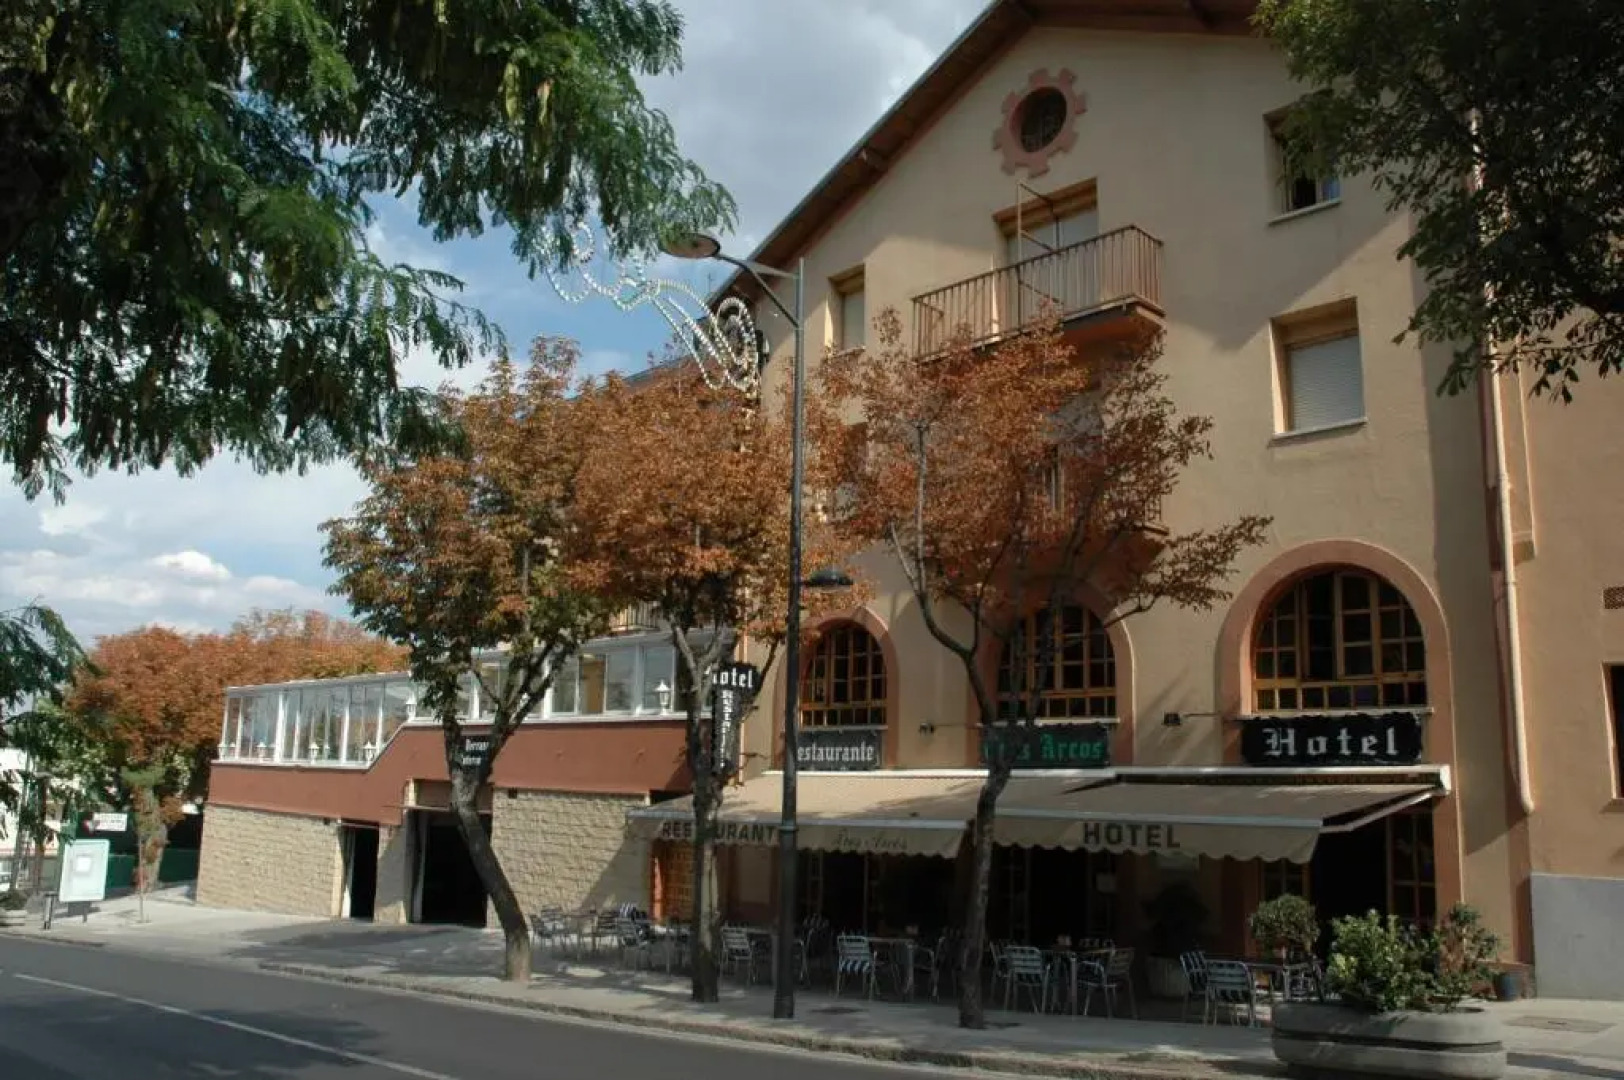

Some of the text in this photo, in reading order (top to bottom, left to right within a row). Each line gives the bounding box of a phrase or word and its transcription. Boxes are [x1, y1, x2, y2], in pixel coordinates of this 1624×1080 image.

[797, 742, 875, 761] estaurante
[1041, 733, 1103, 761] Arcos
[1262, 727, 1398, 756] Hotel
[662, 821, 779, 845] RESURANT
[1083, 822, 1180, 848] HOTEL
